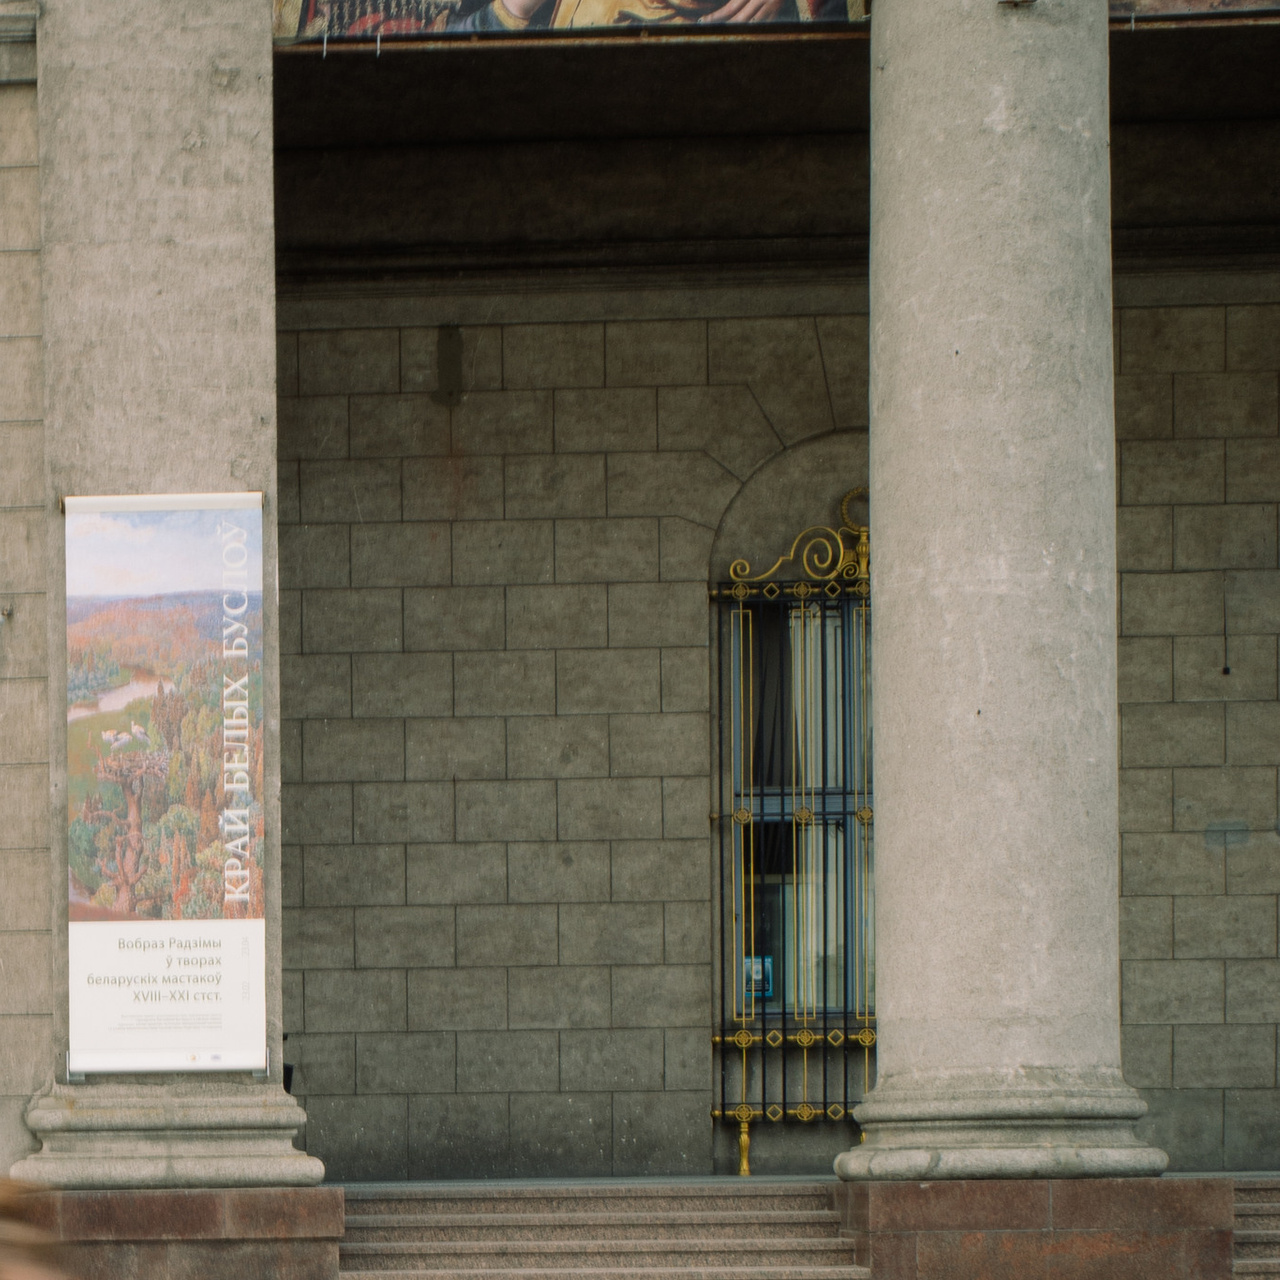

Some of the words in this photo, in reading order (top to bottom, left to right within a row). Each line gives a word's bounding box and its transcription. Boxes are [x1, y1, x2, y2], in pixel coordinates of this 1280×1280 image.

[216, 520, 248, 658] БУСЛОЎ
[223, 674, 249, 792] БЕЛЫХ
[218, 807, 249, 902] КРАЙ
[118, 937, 165, 951] Вобраз
[169, 937, 222, 950] Радзімы
[166, 955, 173, 968] ў
[177, 956, 222, 968] творах
[87, 973, 158, 988] беларускіх
[161, 972, 222, 986] мастакоў
[193, 991, 222, 1001] стст.
